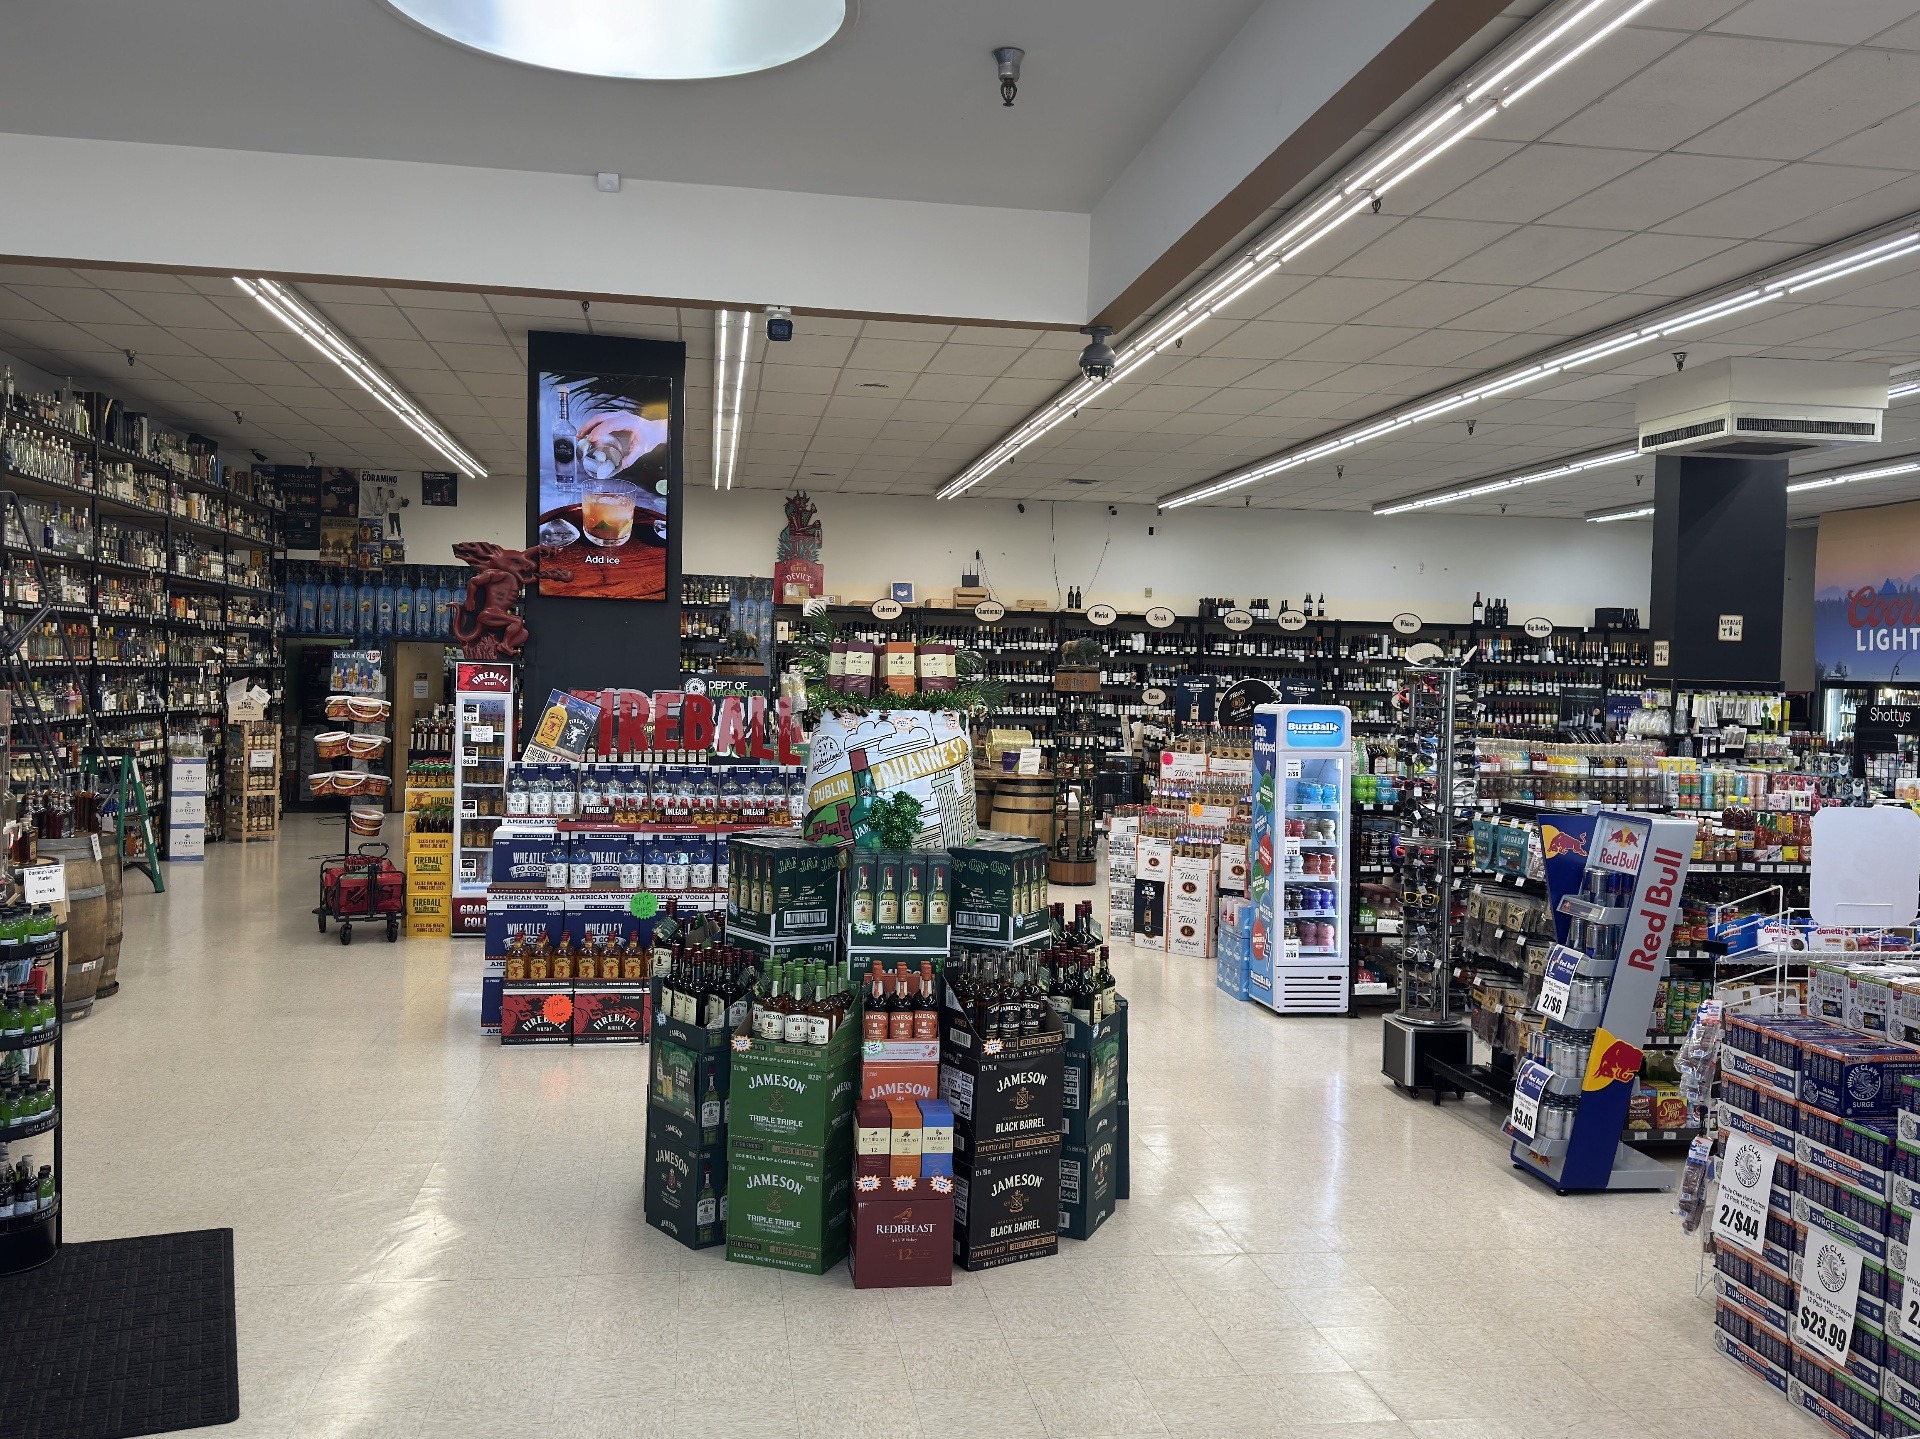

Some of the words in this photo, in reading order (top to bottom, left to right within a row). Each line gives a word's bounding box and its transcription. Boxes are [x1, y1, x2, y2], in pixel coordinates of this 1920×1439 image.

[362, 473, 398, 484] CORAMINO
[585, 556, 604, 564] Add
[606, 556, 620, 564] ice
[786, 572, 812, 582] DEVIL'S
[877, 605, 897, 614] Cabernet
[977, 608, 1002, 616] Chardonnay
[1848, 586, 1920, 628] Coor
[1154, 613, 1166, 622] Syrah
[1400, 620, 1414, 628] Whites
[1527, 623, 1535, 632] Big
[1536, 624, 1550, 632] Bottles
[1856, 628, 1920, 651] LIGHT
[472, 672, 508, 686] FIREBALL
[708, 681, 732, 690] DEPT
[734, 681, 748, 690] OF
[708, 689, 766, 698] IMAGINATION
[1229, 689, 1246, 700] Tito's
[569, 718, 590, 731] FIREBALL
[1870, 707, 1911, 728] Shottys
[1254, 742, 1276, 755] dropped
[878, 738, 964, 786] DUANNE'S!
[1174, 770, 1194, 778] Tito's
[814, 778, 850, 804] DUBLIN
[586, 806, 609, 814] UNLEASH
[414, 856, 442, 865] FIREBALL
[1600, 848, 1618, 866] Red
[1618, 852, 1639, 871] Bull
[1180, 872, 1200, 881] Tito's
[1644, 847, 1684, 908] Bull
[413, 898, 442, 907] FIREBALL
[460, 904, 487, 914] GRAB
[1178, 916, 1197, 925] Tito's
[507, 923, 546, 935] WHEATLEY
[584, 923, 623, 935] WHEATLEY
[1628, 909, 1668, 972] Red
[1543, 994, 1562, 1014] 2/$6
[593, 1013, 637, 1031] FIREBALL
[1737, 1060, 1755, 1074] SURGE
[748, 1074, 806, 1094] JAMESON
[997, 1072, 1047, 1093] JAMESON
[1848, 1066, 1859, 1088] WHITE
[1860, 1065, 1879, 1076] CLAW
[869, 1082, 931, 1100] JAMESON
[1660, 1101, 1683, 1116] Stove
[1668, 1110, 1680, 1120] Top
[749, 1114, 775, 1124] TRIPLE
[777, 1118, 804, 1128] TRIPLE
[996, 1121, 1018, 1133] BLACK
[1020, 1117, 1045, 1130] BARREL
[1514, 1107, 1533, 1131] $3.49
[1733, 1117, 1753, 1132] SURGE
[1091, 1145, 1112, 1172] JAMESON
[1734, 1145, 1747, 1167] WHITE
[1748, 1144, 1761, 1162] CLAW
[1814, 1153, 1837, 1170] SURGE
[656, 1149, 689, 1178] JAMESON
[747, 1174, 803, 1195] JAMESON
[991, 1174, 1042, 1197] JAMESON
[747, 1214, 773, 1224] TRIPLE
[775, 1218, 801, 1228] TRIPLE
[990, 1224, 1012, 1238] BLACK
[1014, 1219, 1040, 1233] BARREL
[1720, 1204, 1759, 1241] 2/$44
[1812, 1213, 1835, 1230] SURGE
[876, 1224, 934, 1235] REDBREAST
[898, 1249, 912, 1260] 12
[1816, 1245, 1830, 1268] WHITE
[1830, 1244, 1846, 1266] CLAW
[1727, 1287, 1748, 1305] SURGE
[1800, 1305, 1847, 1352] $23.99
[1728, 1344, 1748, 1363] SURGE
[1806, 1397, 1829, 1419] SURGE
[1904, 1393, 1920, 1410] SUR
